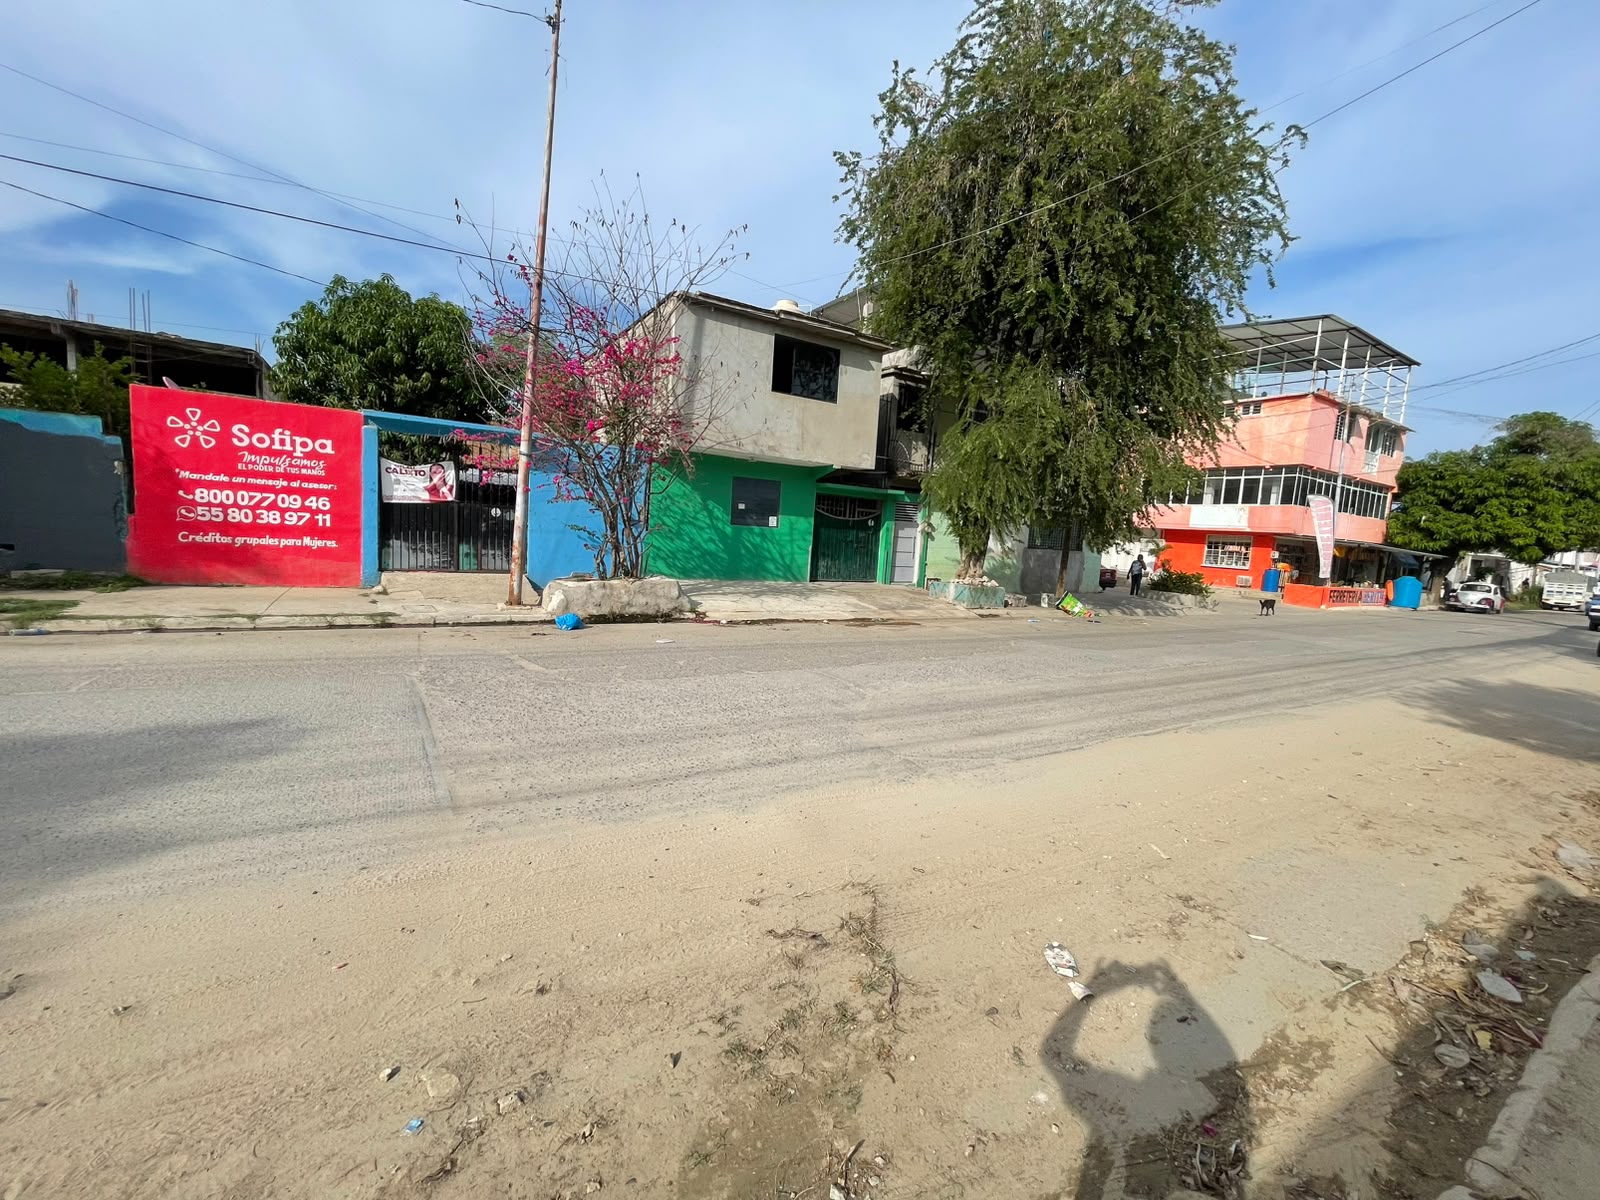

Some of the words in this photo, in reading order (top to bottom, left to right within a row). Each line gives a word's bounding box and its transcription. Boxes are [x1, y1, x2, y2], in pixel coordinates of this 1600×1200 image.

[231, 424, 335, 457] Sofipa
[238, 451, 327, 470] Impulsamos
[248, 464, 274, 473] PODER
[301, 468, 326, 476] MANOS
[247, 477, 288, 489] mensaje
[290, 479, 300, 488] al
[302, 482, 338, 490] asesor:
[194, 488, 234, 505] 800
[236, 490, 276, 507] 077
[277, 494, 302, 509] 09
[304, 496, 331, 511] 46
[196, 506, 224, 522] 55
[227, 507, 253, 524] 80
[255, 509, 281, 525] 38
[284, 512, 311, 526] 97
[314, 513, 331, 527] 11
[178, 531, 233, 544] Créditos
[234, 535, 279, 547] grupales
[280, 537, 301, 548] para
[303, 536, 338, 549] Mujeres.
